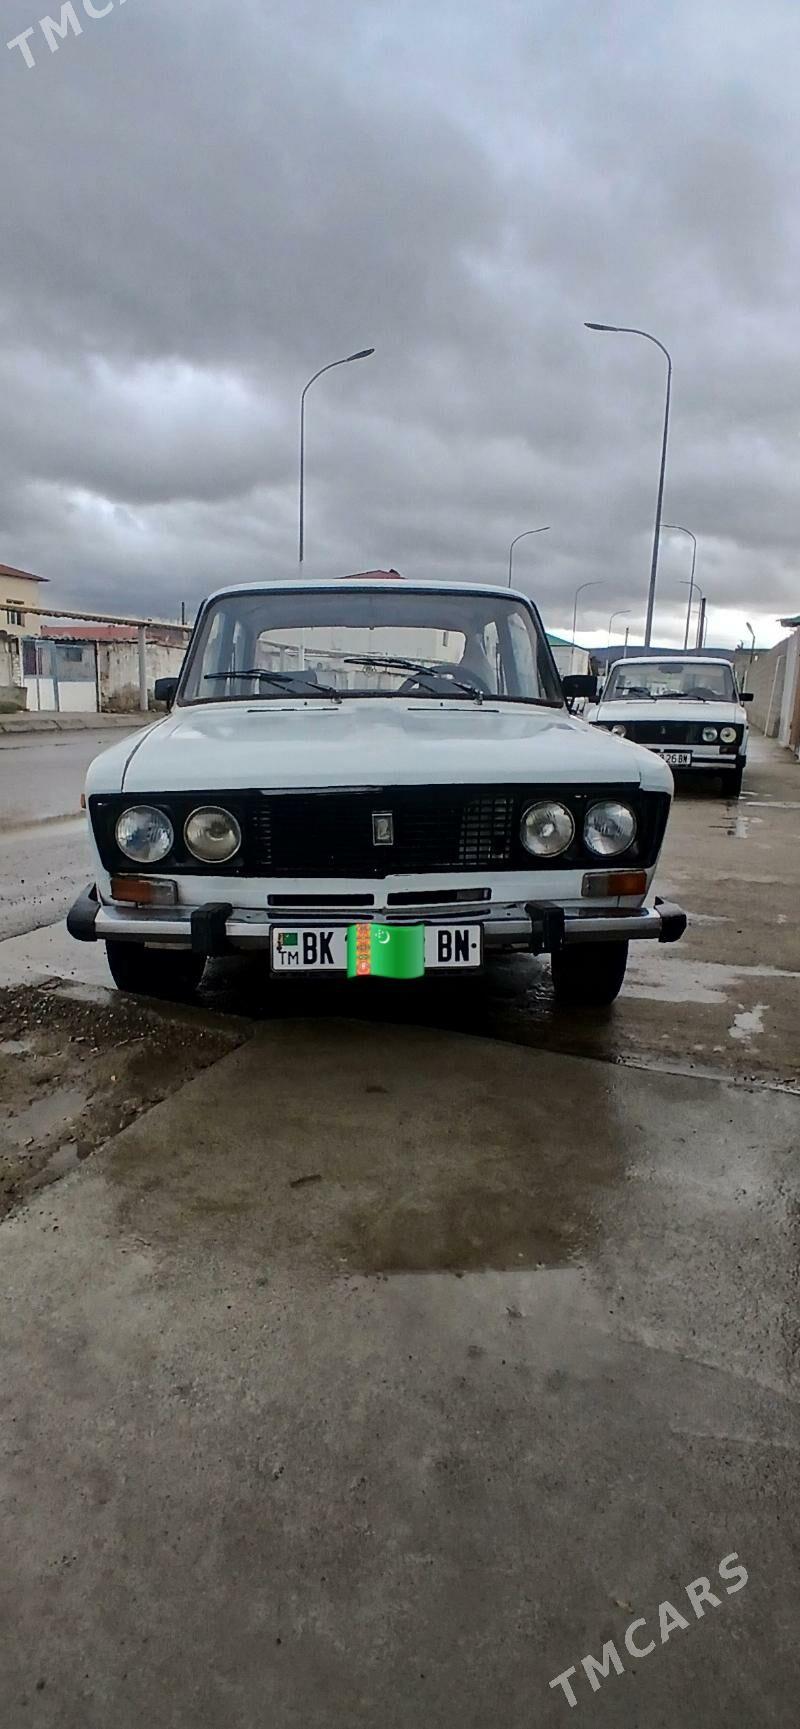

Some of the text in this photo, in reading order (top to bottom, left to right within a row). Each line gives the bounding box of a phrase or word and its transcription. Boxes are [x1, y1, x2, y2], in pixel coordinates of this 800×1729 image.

[278, 951, 299, 965] TM
[302, 931, 334, 965] BK
[437, 929, 470, 963] BN
